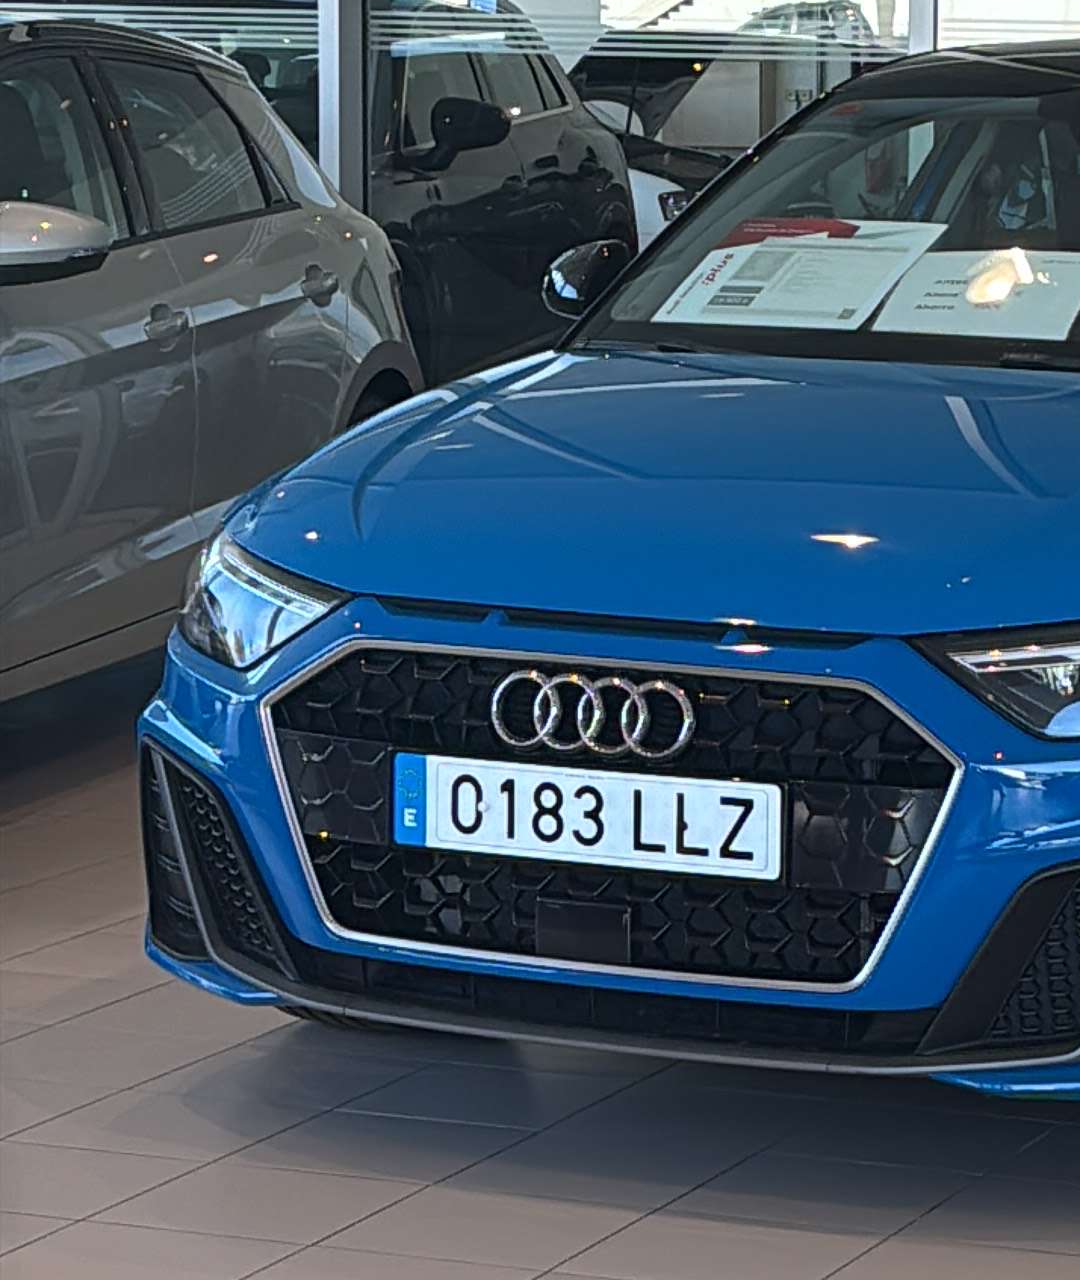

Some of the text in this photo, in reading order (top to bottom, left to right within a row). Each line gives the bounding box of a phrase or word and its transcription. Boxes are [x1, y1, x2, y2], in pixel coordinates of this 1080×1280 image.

[404, 808, 417, 827] E
[450, 773, 755, 862] 0183 LLZ
